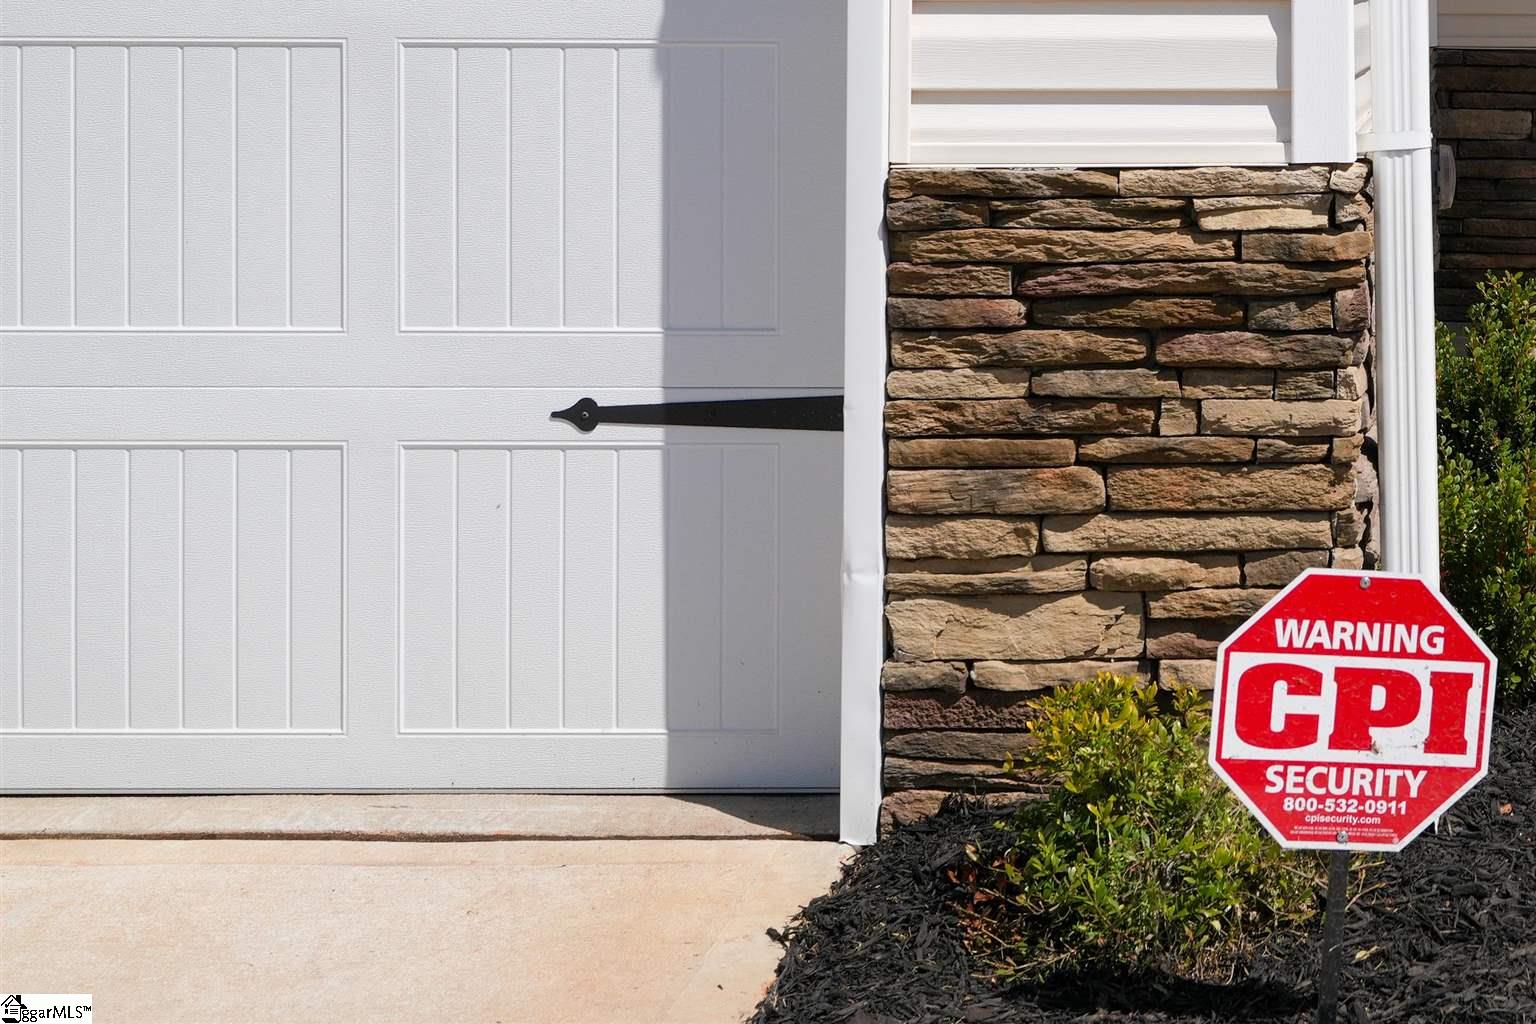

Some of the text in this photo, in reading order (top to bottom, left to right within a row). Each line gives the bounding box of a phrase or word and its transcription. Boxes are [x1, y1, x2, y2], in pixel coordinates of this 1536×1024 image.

[1274, 618, 1446, 656] WARNING
[1234, 662, 1475, 756] CPI
[1264, 764, 1428, 799] SECURITY
[1282, 796, 1407, 815] 800-532-0911
[1304, 814, 1381, 825] cpisecurity.com
